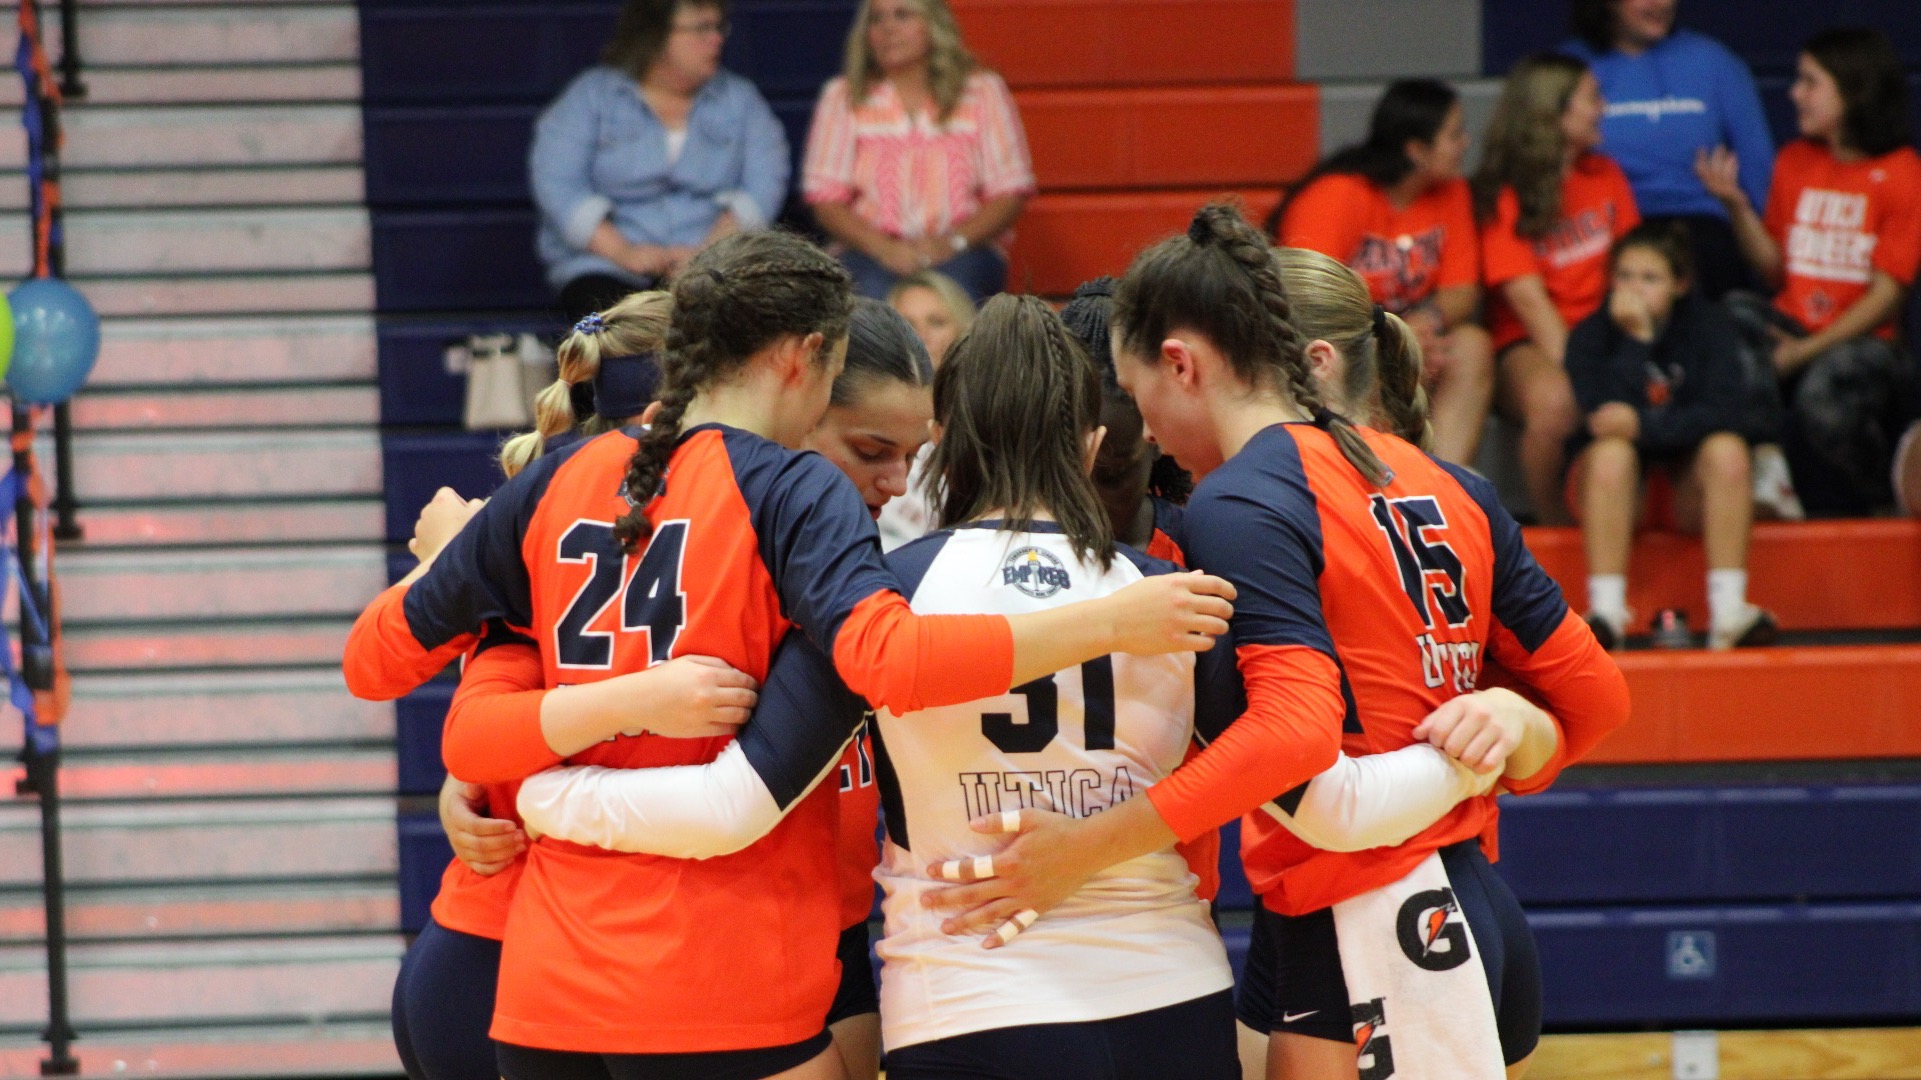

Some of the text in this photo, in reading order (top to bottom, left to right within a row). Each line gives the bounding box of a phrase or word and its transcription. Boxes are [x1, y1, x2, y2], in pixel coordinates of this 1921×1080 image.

[554, 518, 691, 670] 24
[1369, 493, 1473, 630] 15
[982, 654, 1116, 754] 31
[959, 766, 1134, 822] UTICA
